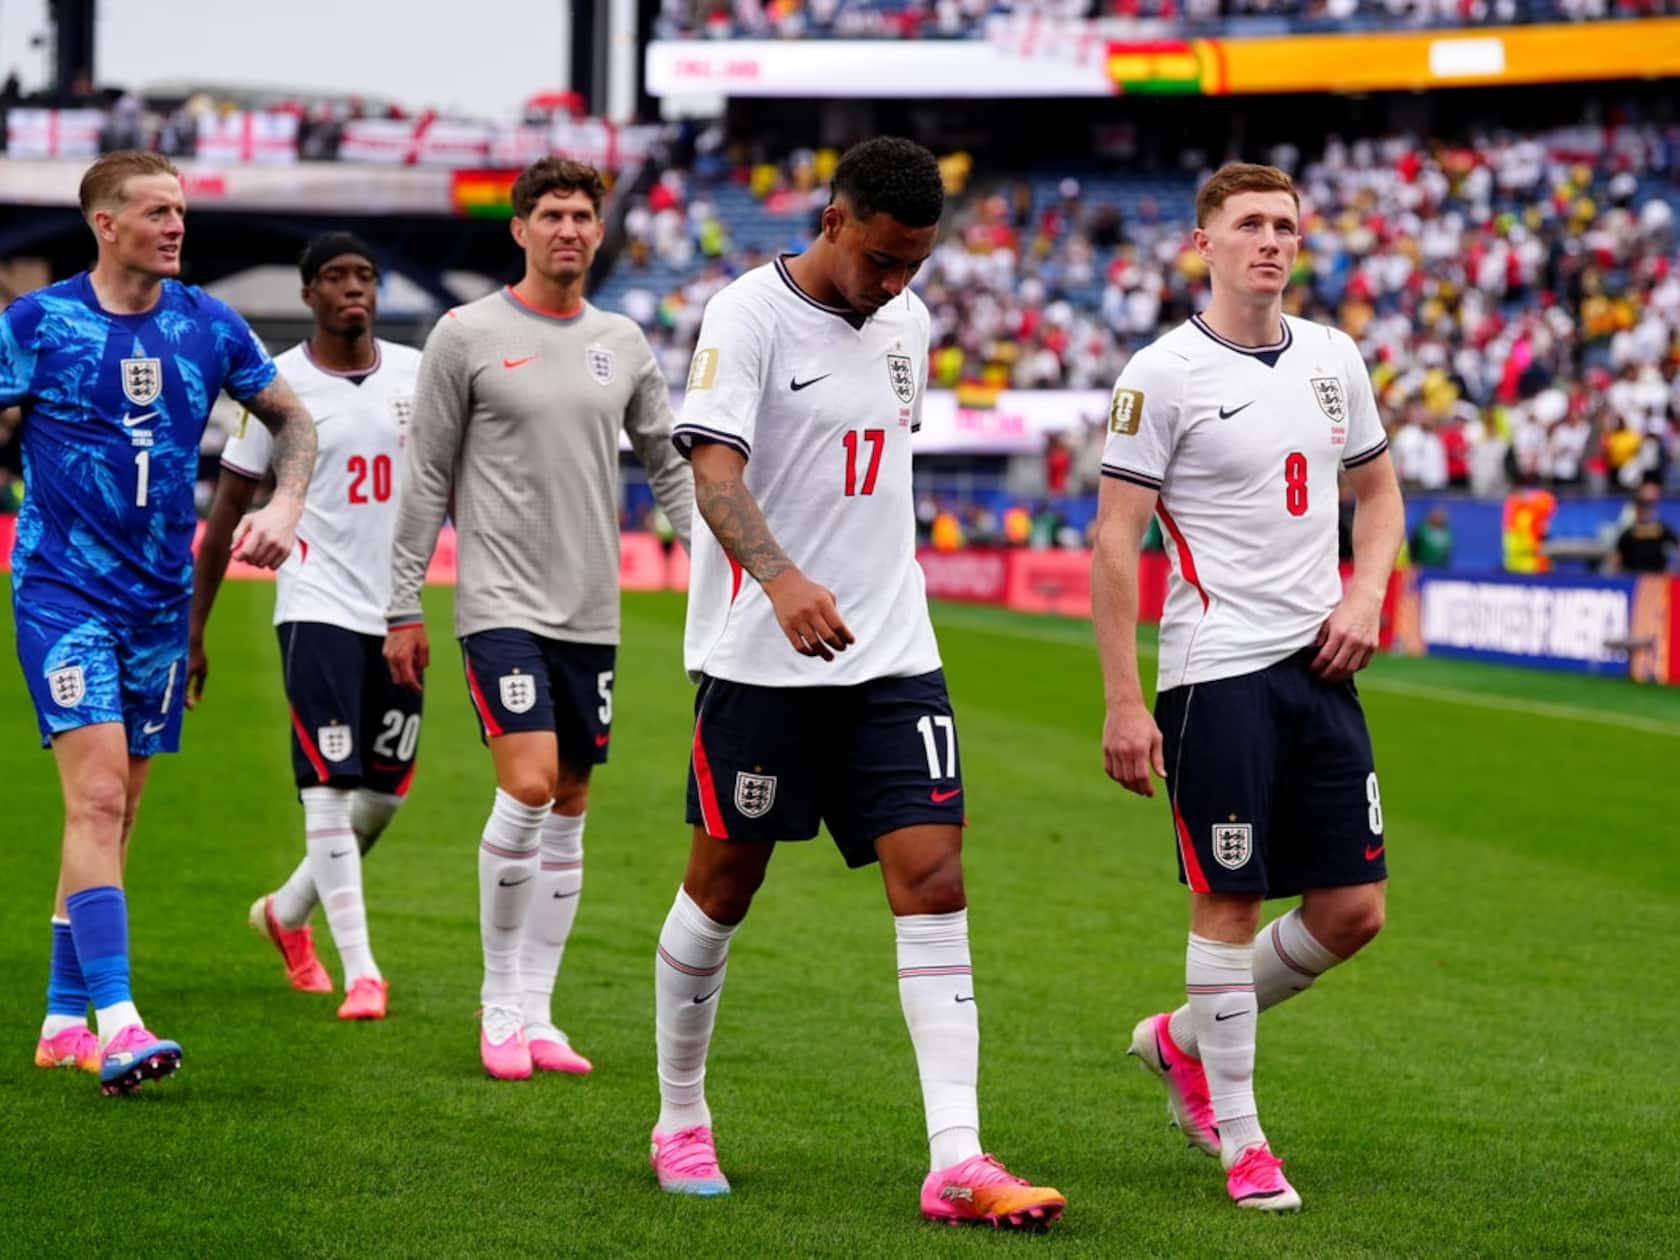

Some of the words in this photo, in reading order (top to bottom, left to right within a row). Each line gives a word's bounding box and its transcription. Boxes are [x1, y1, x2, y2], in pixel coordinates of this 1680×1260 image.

[134, 450, 149, 507] 1
[347, 454, 392, 504] 20
[842, 429, 885, 496] 17
[1285, 452, 1308, 517] 8
[161, 661, 178, 714] 1
[597, 669, 614, 724] 5
[373, 709, 420, 761] 20
[917, 715, 956, 779] 17
[1366, 772, 1383, 834] 8
